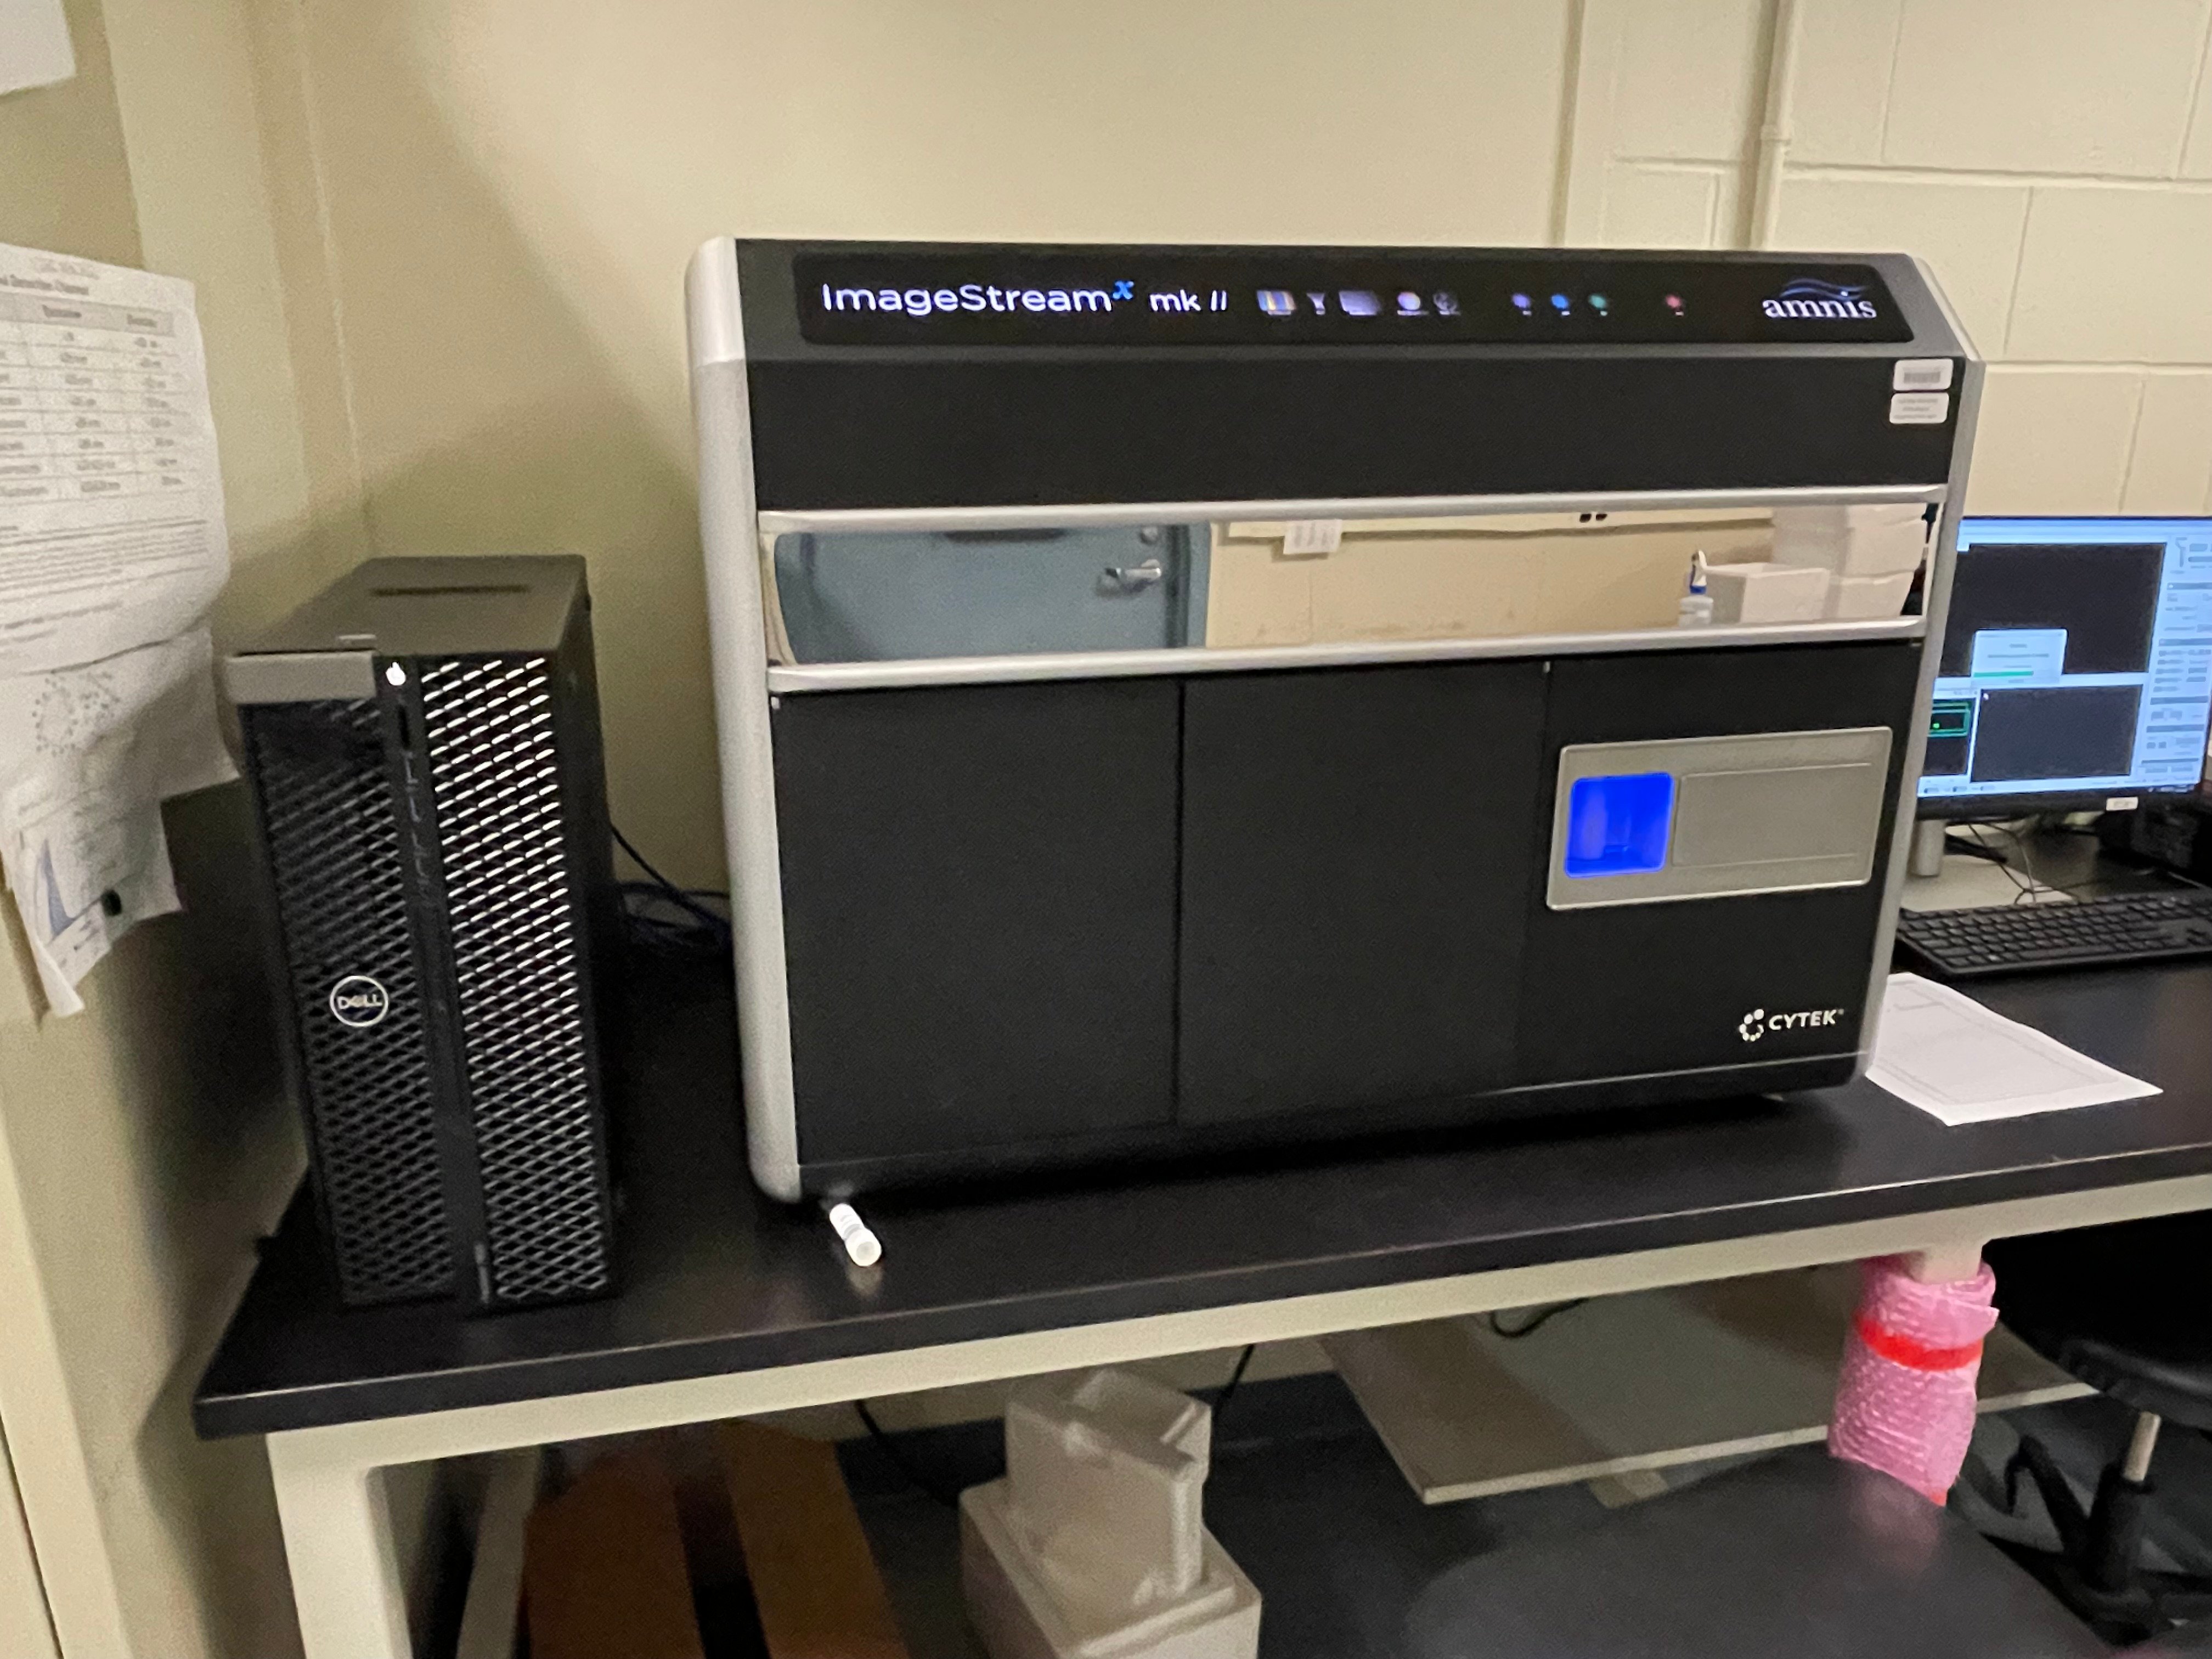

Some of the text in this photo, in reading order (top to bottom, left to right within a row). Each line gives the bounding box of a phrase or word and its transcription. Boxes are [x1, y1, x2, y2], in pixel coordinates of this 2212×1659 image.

[1150, 289, 1201, 312] mk
[1762, 300, 1877, 318] amnis
[1769, 1009, 1837, 1030] CYTEK
